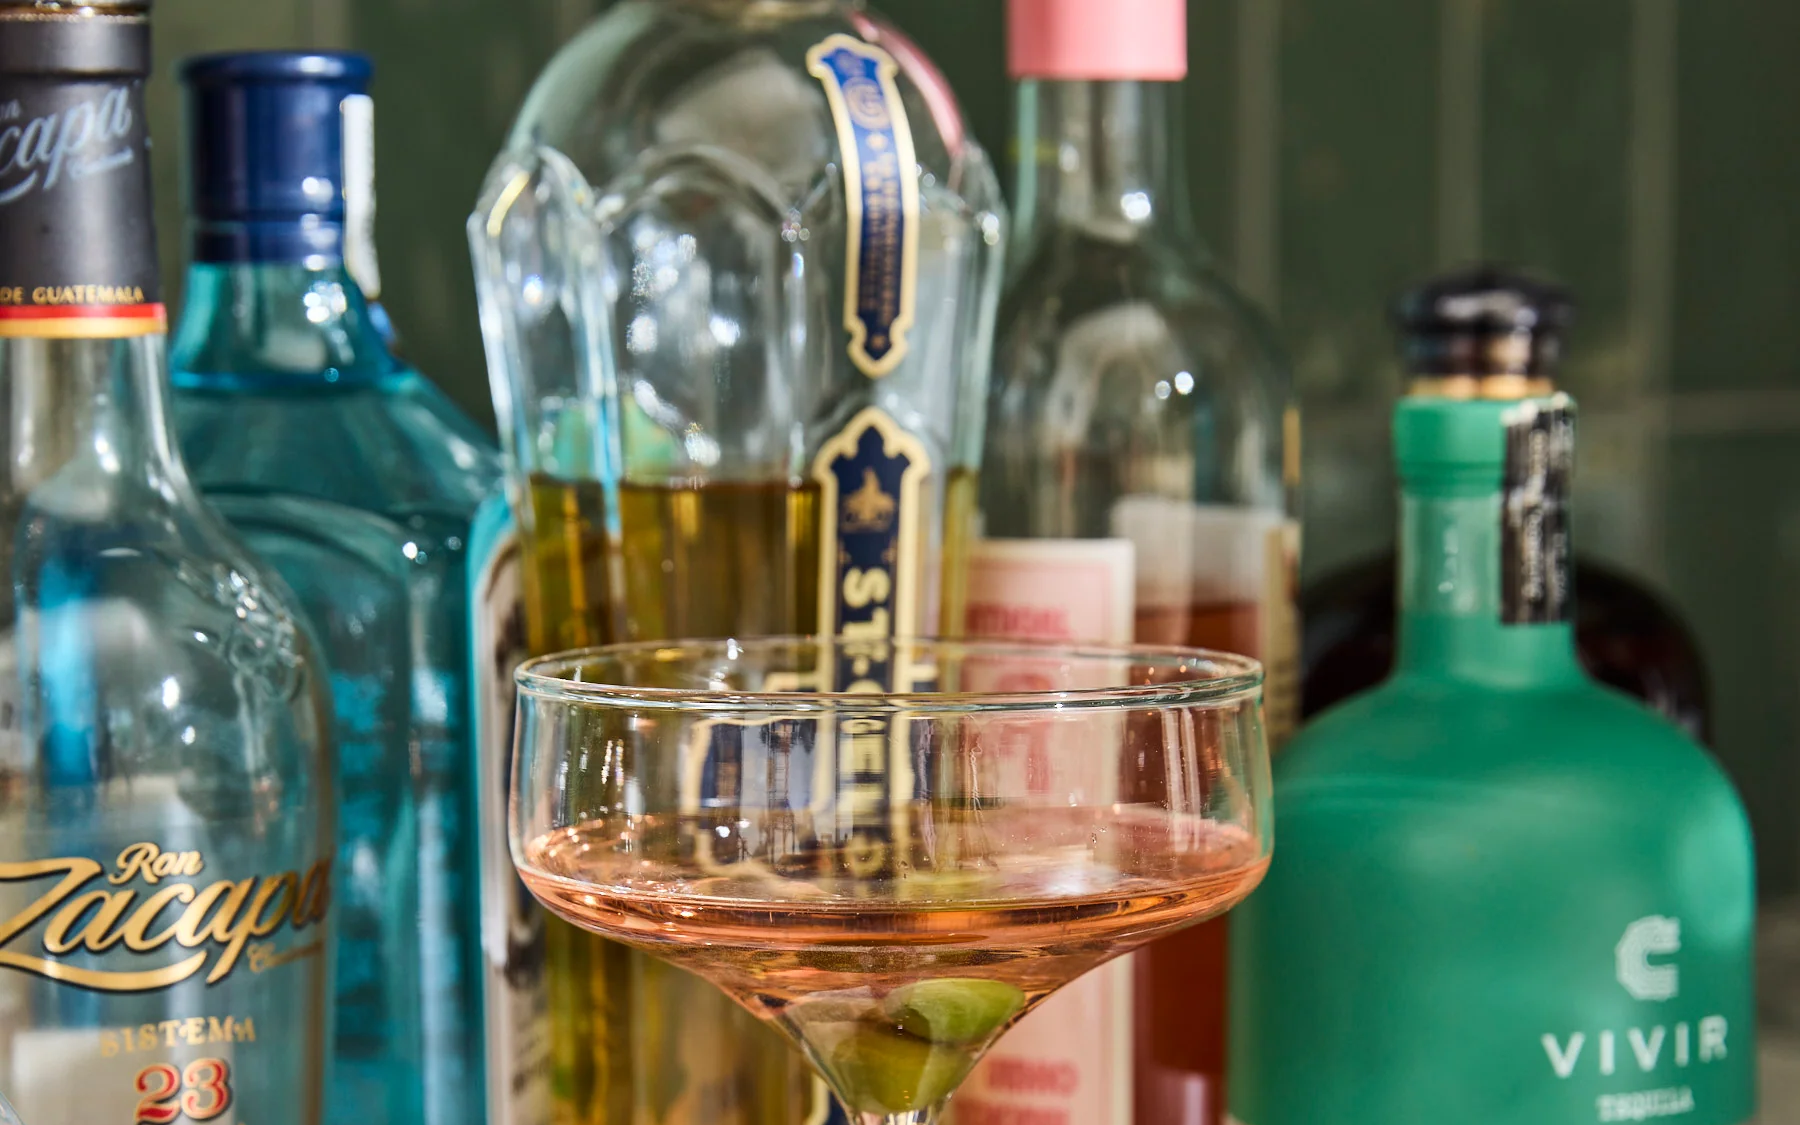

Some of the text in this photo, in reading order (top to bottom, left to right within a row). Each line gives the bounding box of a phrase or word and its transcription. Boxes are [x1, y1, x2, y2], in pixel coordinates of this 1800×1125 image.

[32, 284, 145, 305] GUATEMALA
[108, 842, 204, 885] Ron
[0, 856, 331, 988] Zacapa
[99, 1015, 256, 1058] SISTEMA
[1540, 1013, 1728, 1079] VIVIR
